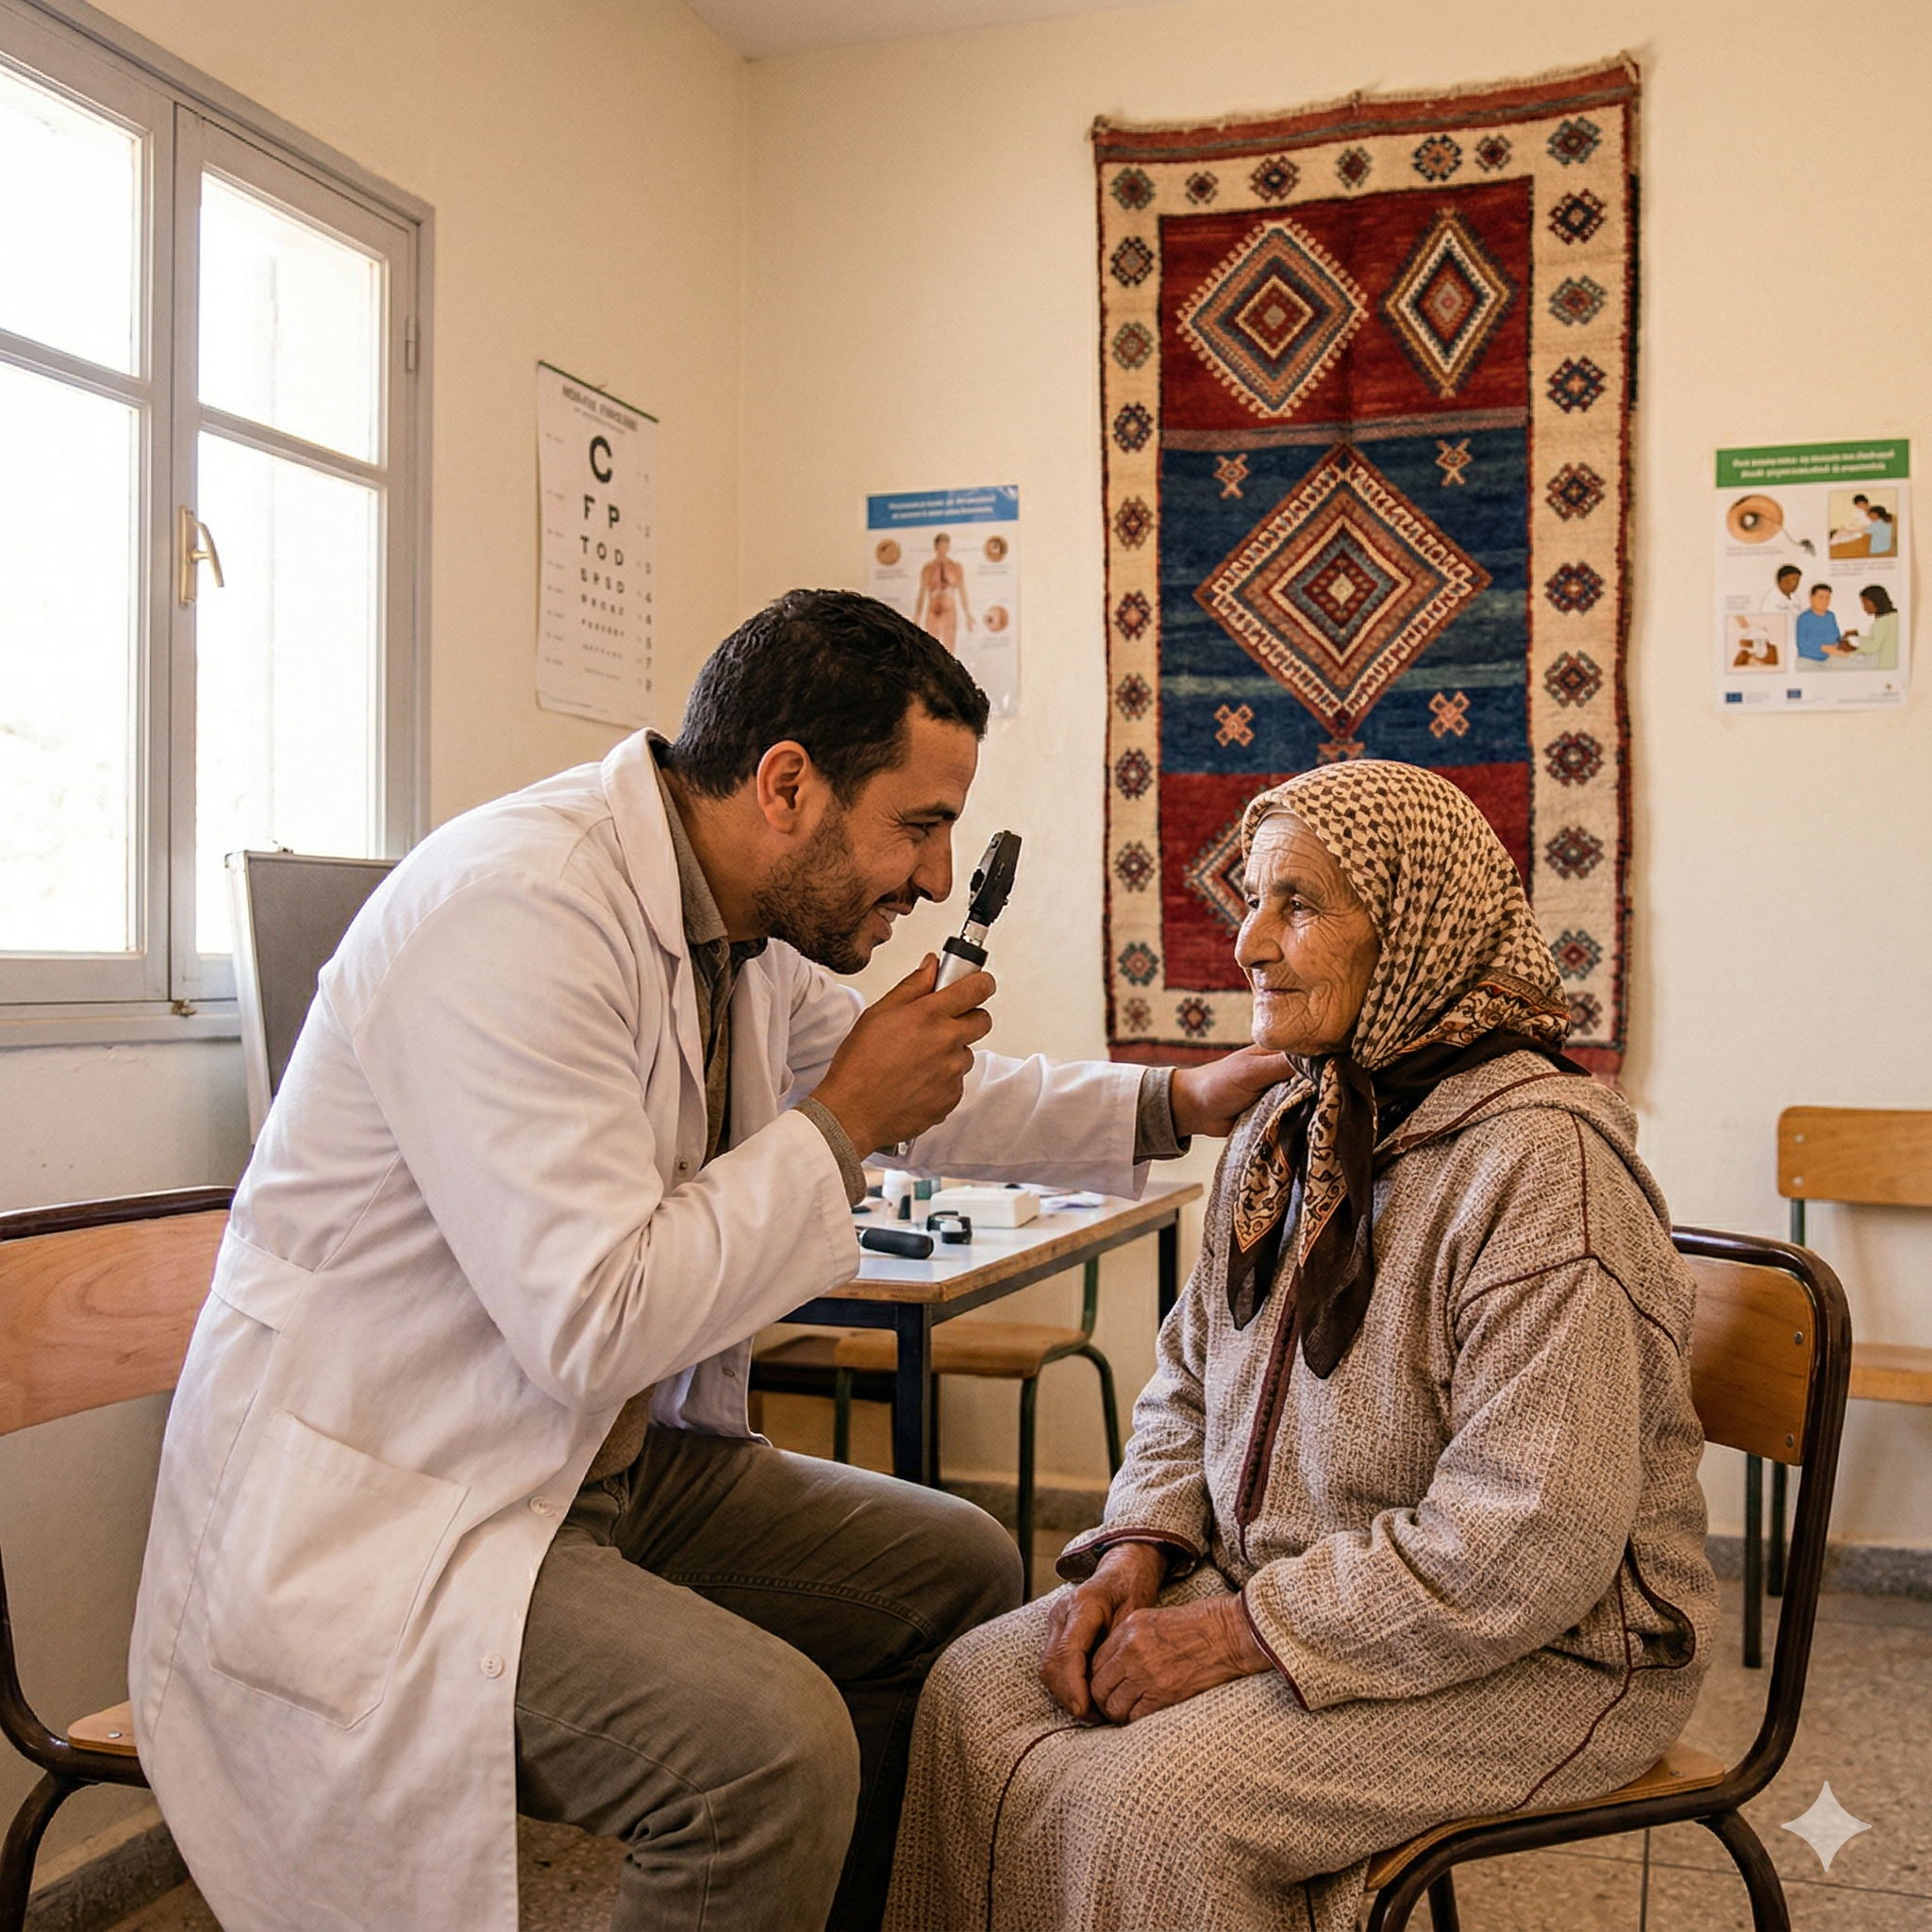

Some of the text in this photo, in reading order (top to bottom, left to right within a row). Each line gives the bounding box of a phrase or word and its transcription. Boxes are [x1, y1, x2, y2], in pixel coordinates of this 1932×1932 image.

[590, 436, 612, 483] C
[584, 494, 620, 528] F P
